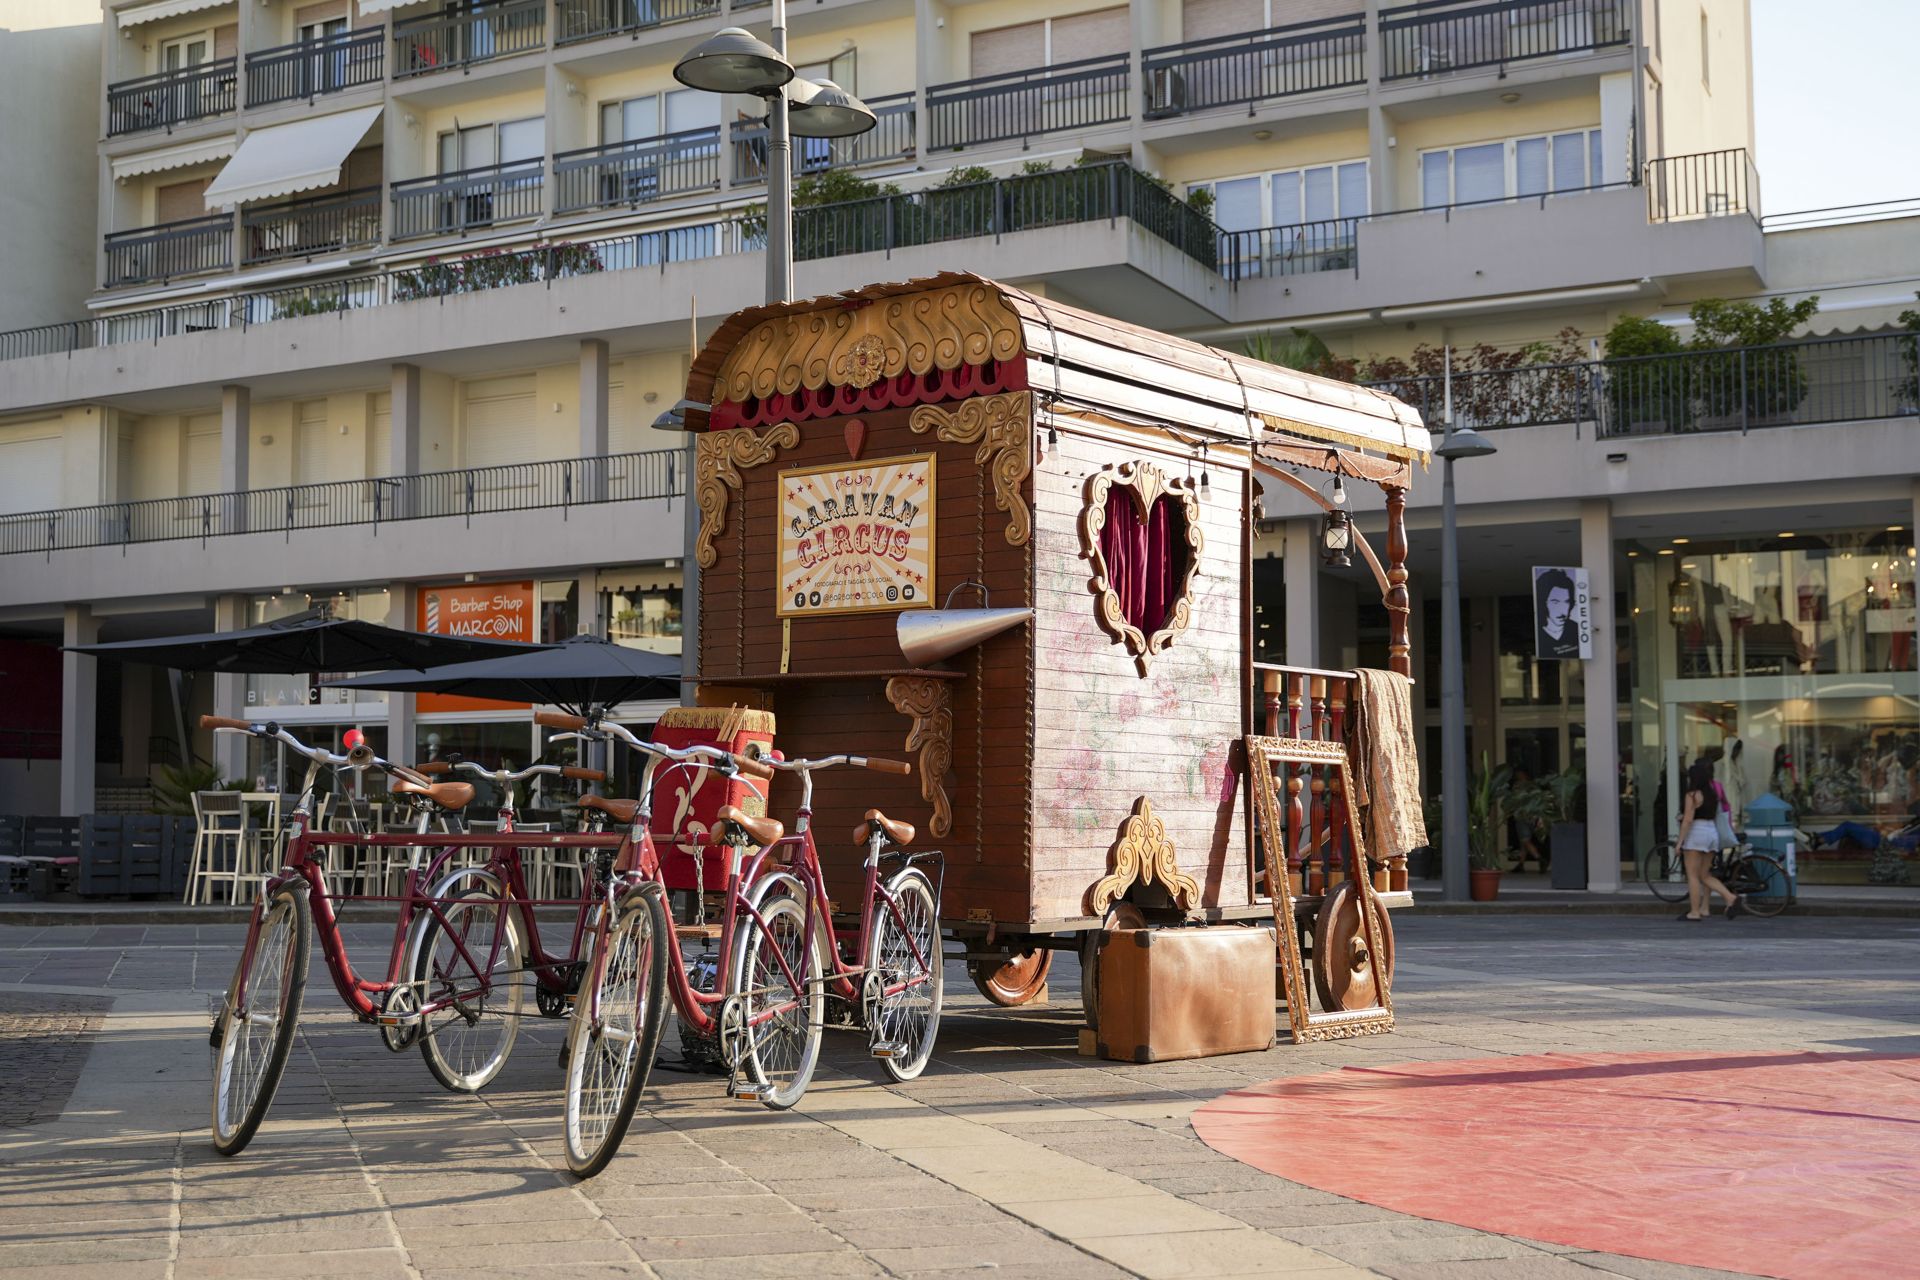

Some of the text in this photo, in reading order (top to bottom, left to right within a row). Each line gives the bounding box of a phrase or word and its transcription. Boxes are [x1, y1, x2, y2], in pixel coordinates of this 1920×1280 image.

[791, 493, 919, 538] CARAVAN
[797, 523, 911, 569] CIRCUS
[450, 596, 523, 613] Barber Shop
[1579, 594, 1589, 643] DECO
[449, 614, 523, 637] MARCONI
[247, 688, 348, 703] BLANCHE
